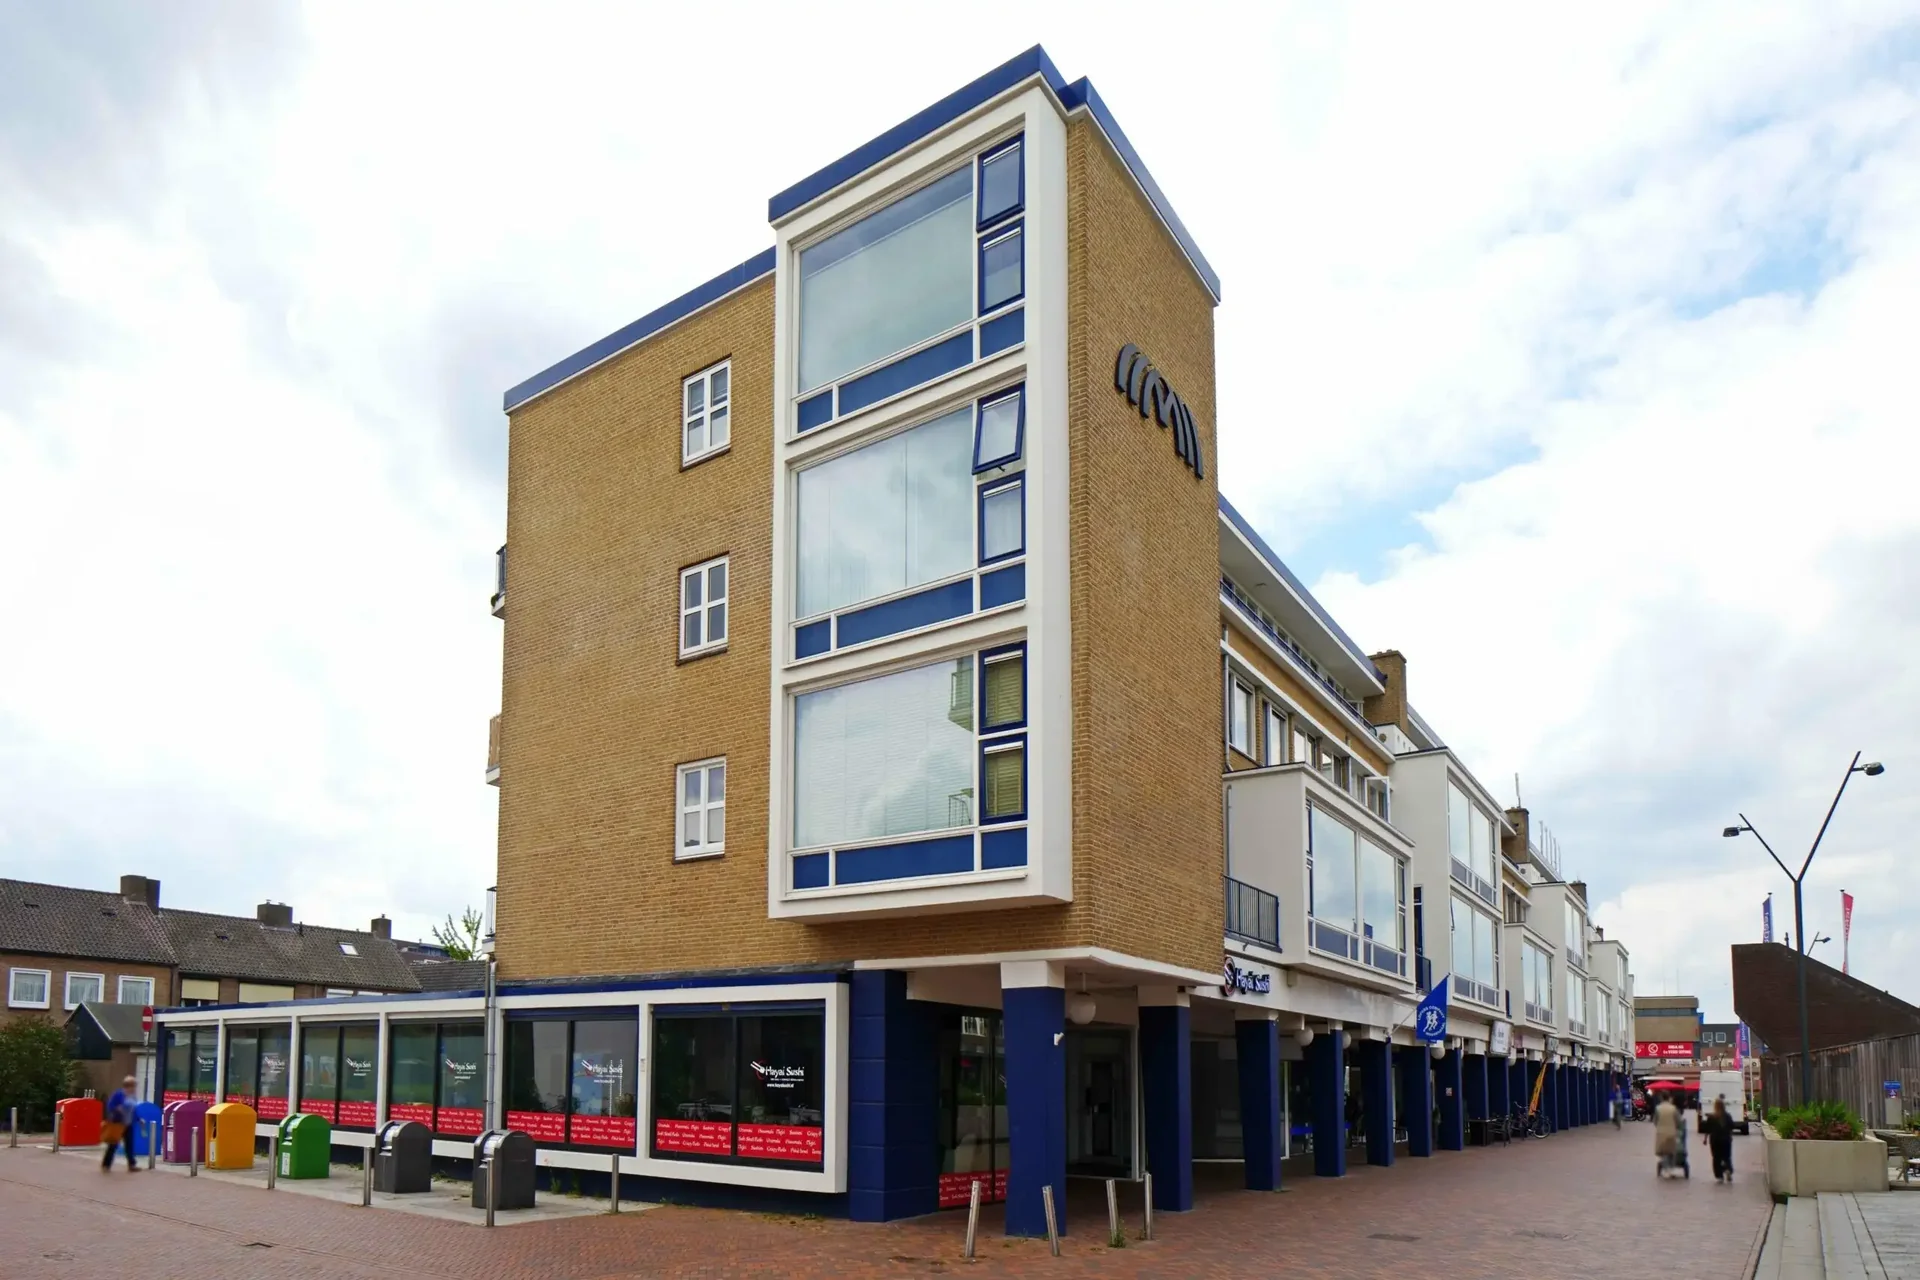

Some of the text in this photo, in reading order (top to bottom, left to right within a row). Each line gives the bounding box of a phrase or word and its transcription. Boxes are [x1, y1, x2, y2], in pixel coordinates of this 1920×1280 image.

[1235, 967, 1270, 995] Hayai Sushi
[765, 1066, 805, 1078] Hayai Sushi
